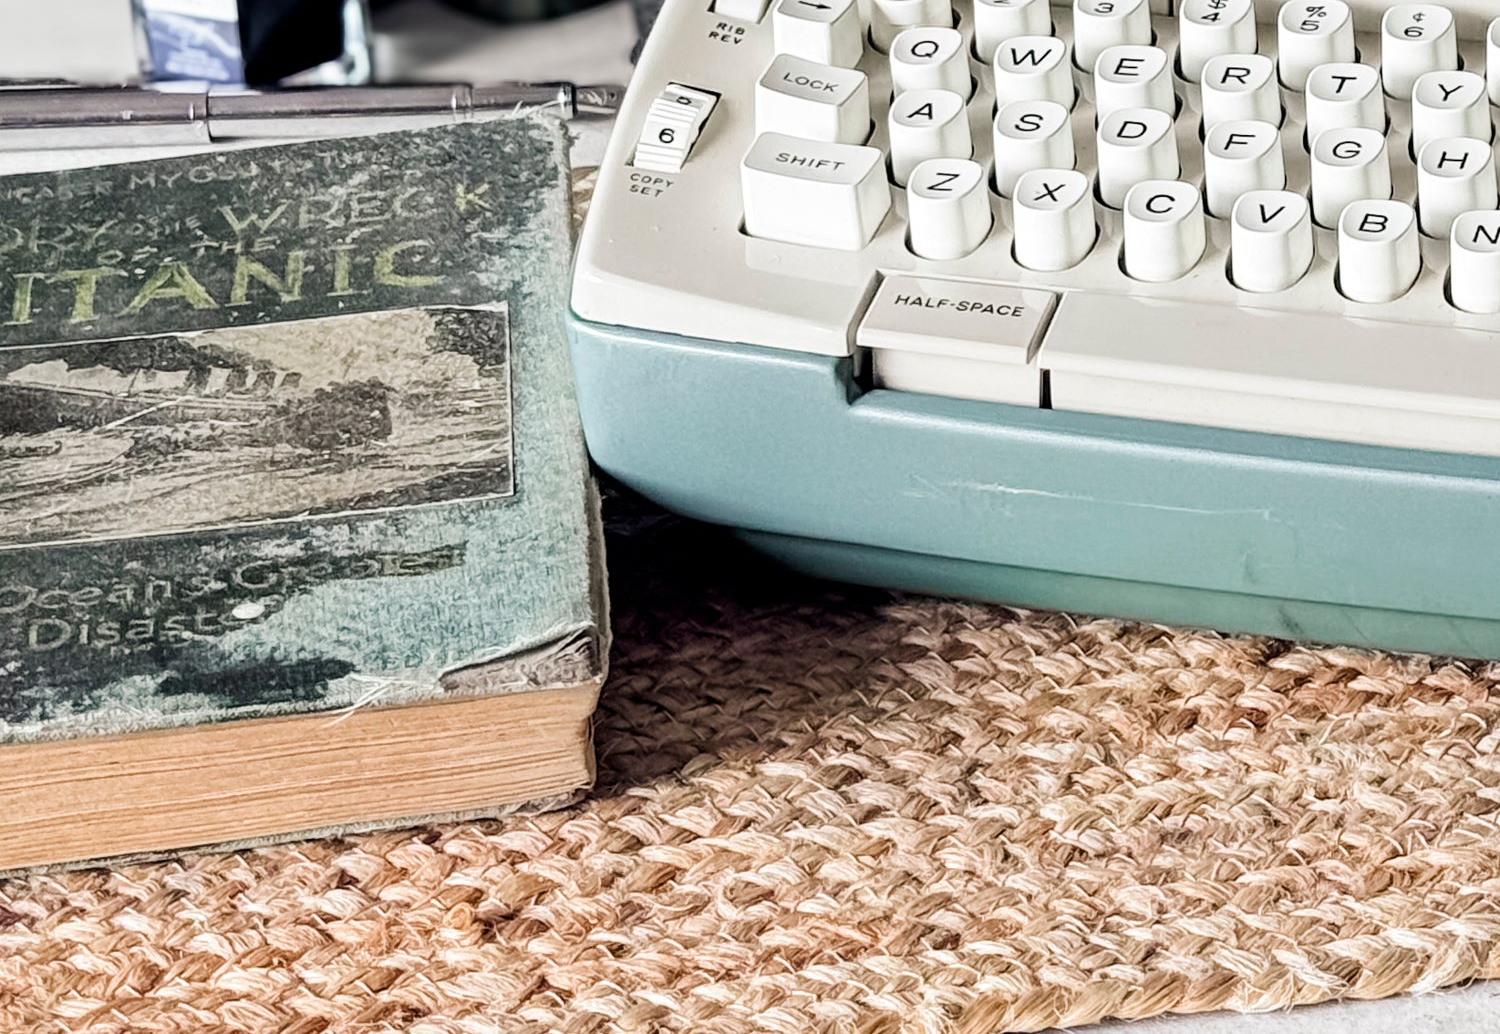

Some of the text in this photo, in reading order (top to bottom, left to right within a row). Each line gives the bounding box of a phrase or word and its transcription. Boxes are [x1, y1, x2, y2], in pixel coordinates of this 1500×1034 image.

[1095, 2, 1115, 14] 3
[1200, 11, 1221, 23] 4
[1300, 19, 1320, 32] 5
[1403, 26, 1423, 38] 6
[1305, 5, 1327, 18] %
[708, 30, 743, 45] REV
[716, 21, 746, 36] RIB
[910, 40, 940, 58] Q
[1010, 47, 1053, 67] W
[1113, 58, 1145, 76] E
[1220, 66, 1251, 84] R
[1330, 75, 1357, 94] T
[1437, 83, 1464, 102] Y
[782, 71, 840, 94] LOCK
[658, 127, 675, 144] 6
[906, 102, 935, 121] A
[1014, 113, 1044, 132] S
[1116, 120, 1148, 139] D
[1223, 133, 1256, 151] F
[1332, 140, 1363, 159] G
[1436, 150, 1469, 170] H
[775, 151, 846, 172] SHIFT
[630, 172, 675, 188] COPY
[629, 184, 665, 198] SET
[926, 172, 961, 192] Z
[1033, 182, 1066, 203] X
[1145, 194, 1176, 214] C
[1259, 203, 1286, 224] V
[1358, 213, 1389, 234] B
[893, 294, 1026, 318] HALF-SPACE
